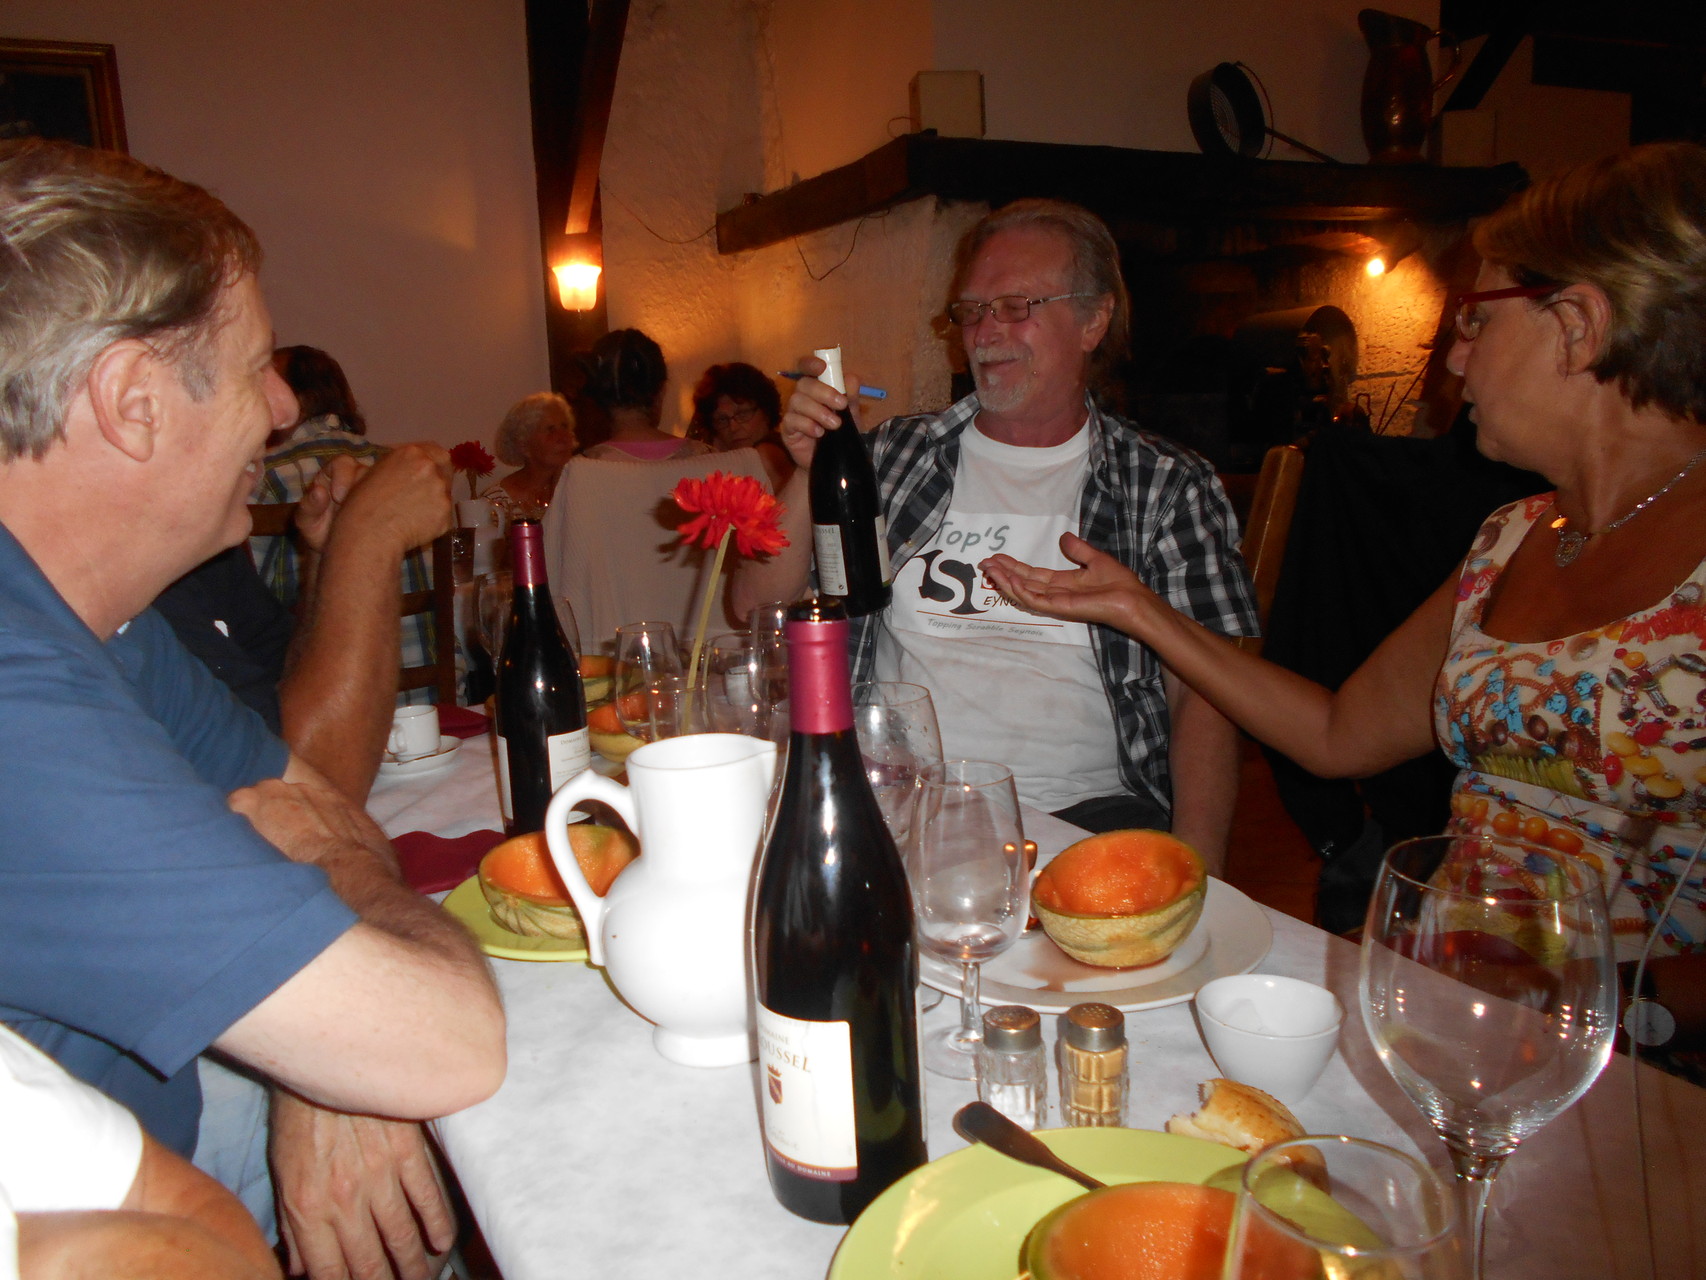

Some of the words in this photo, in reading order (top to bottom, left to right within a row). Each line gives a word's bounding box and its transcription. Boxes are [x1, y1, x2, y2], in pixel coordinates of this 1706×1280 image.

[934, 521, 1010, 553] Top'S
[927, 618, 962, 630] Topping
[797, 1164, 832, 1177] DOMAINE
